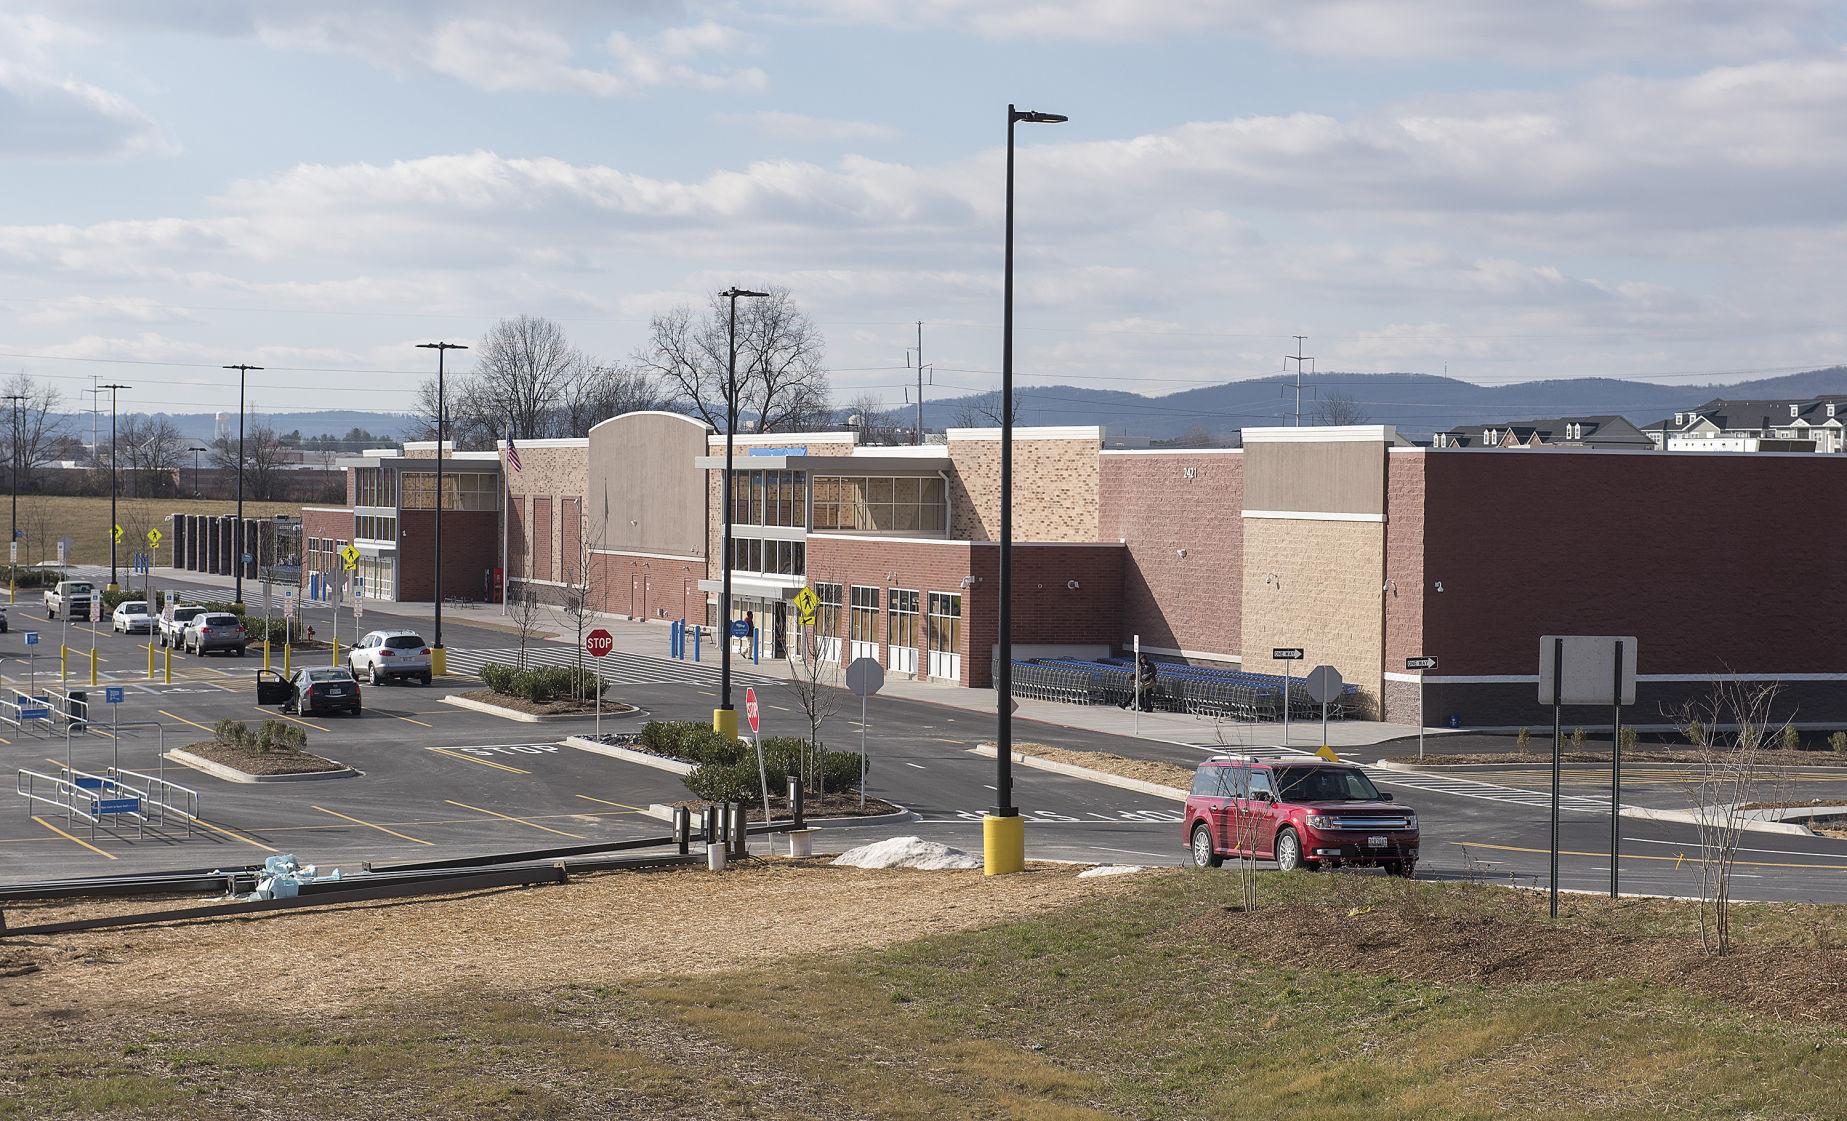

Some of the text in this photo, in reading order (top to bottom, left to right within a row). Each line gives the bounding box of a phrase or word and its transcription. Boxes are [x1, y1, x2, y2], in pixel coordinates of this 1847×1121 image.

[587, 637, 612, 649] STOP
[746, 701, 759, 719] STOP
[460, 745, 559, 756] STOP
